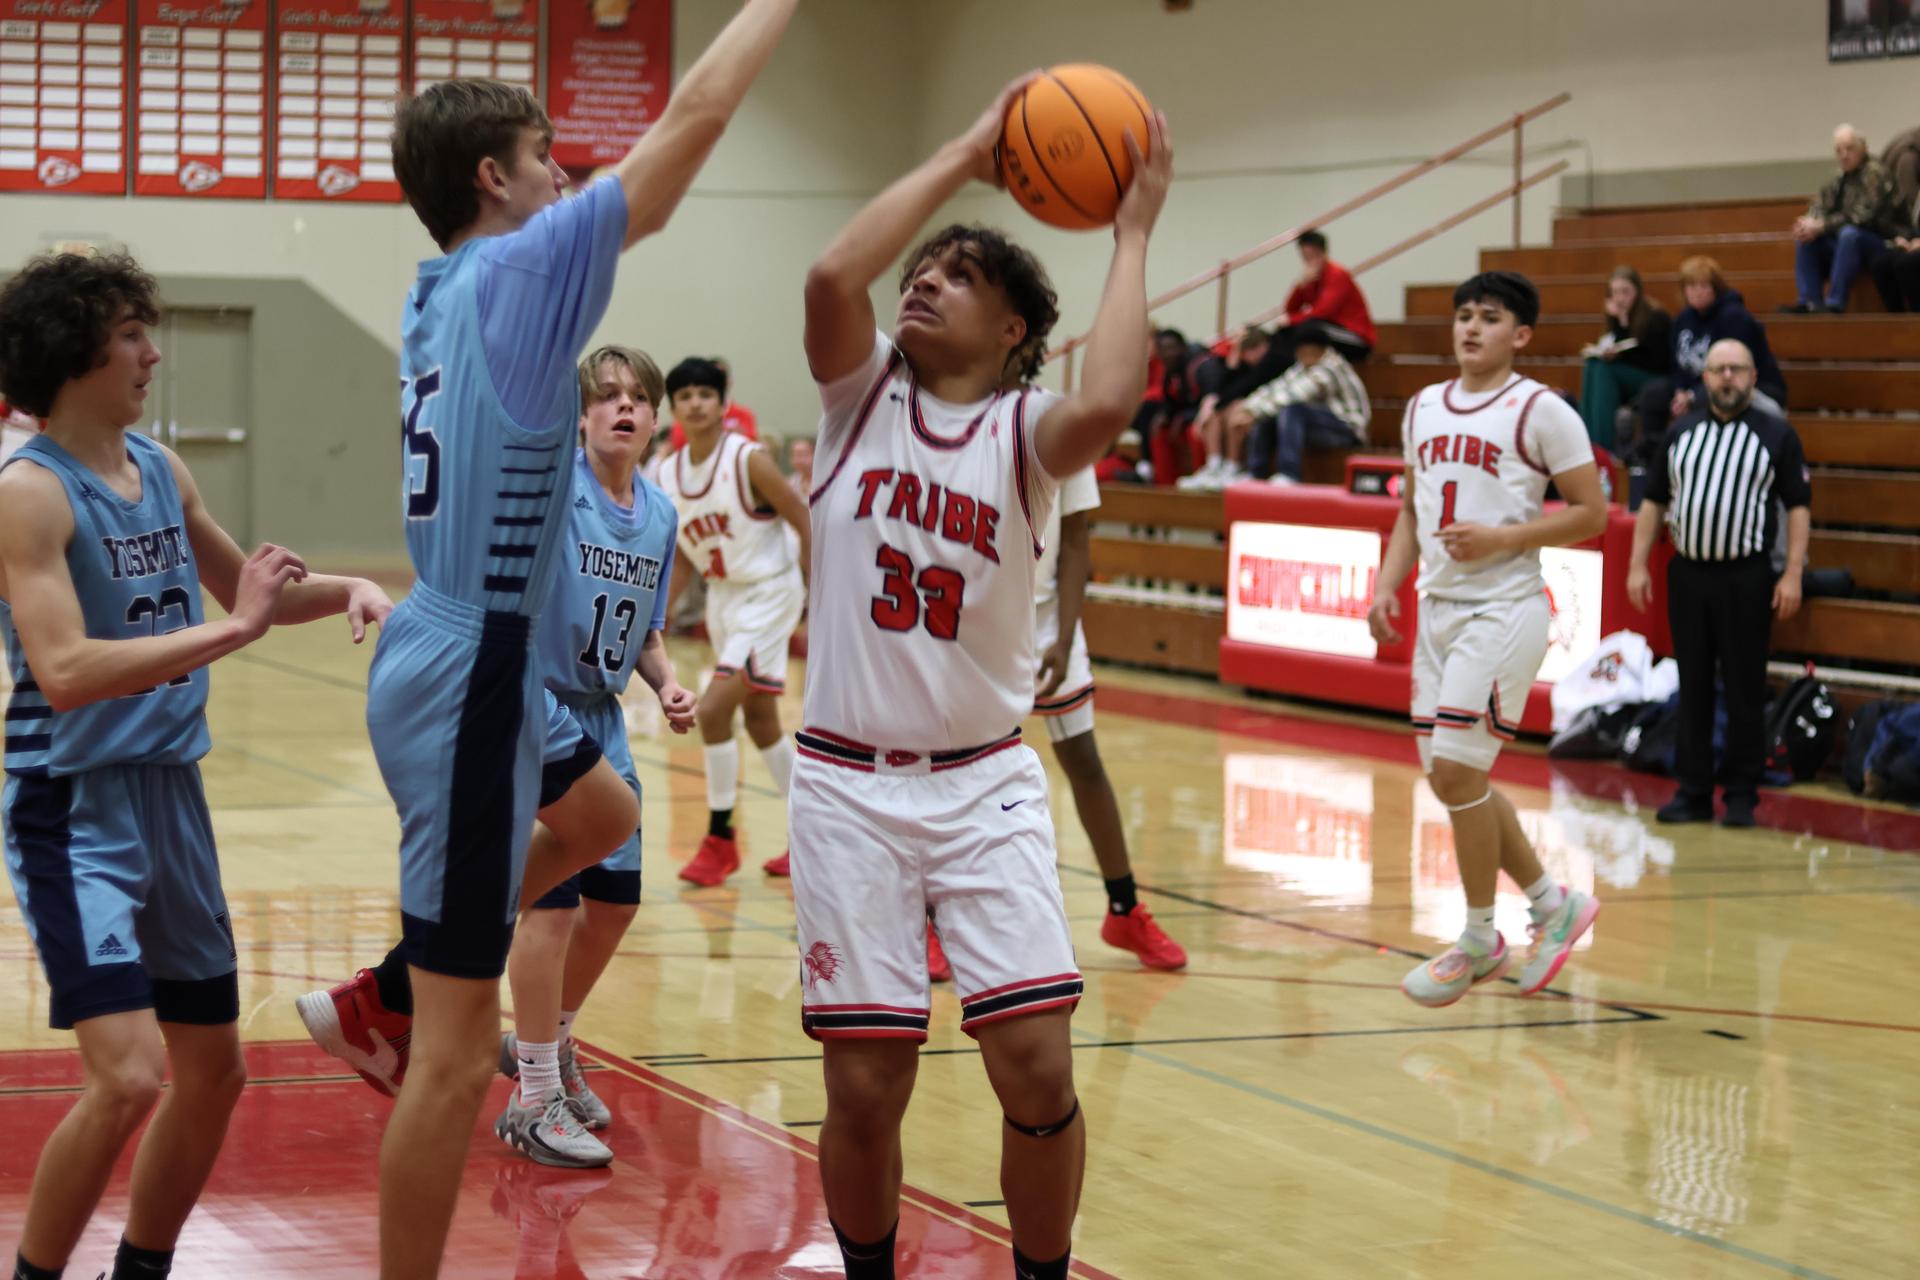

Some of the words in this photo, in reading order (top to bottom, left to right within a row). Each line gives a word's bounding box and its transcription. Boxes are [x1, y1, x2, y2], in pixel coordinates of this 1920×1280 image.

[400, 364, 442, 521] 5
[1418, 434, 1502, 479] TRIBE
[854, 468, 1001, 567] TRIBE
[1439, 480, 1458, 530] 1
[578, 542, 661, 591] YOSEMITE
[577, 592, 638, 675] 13
